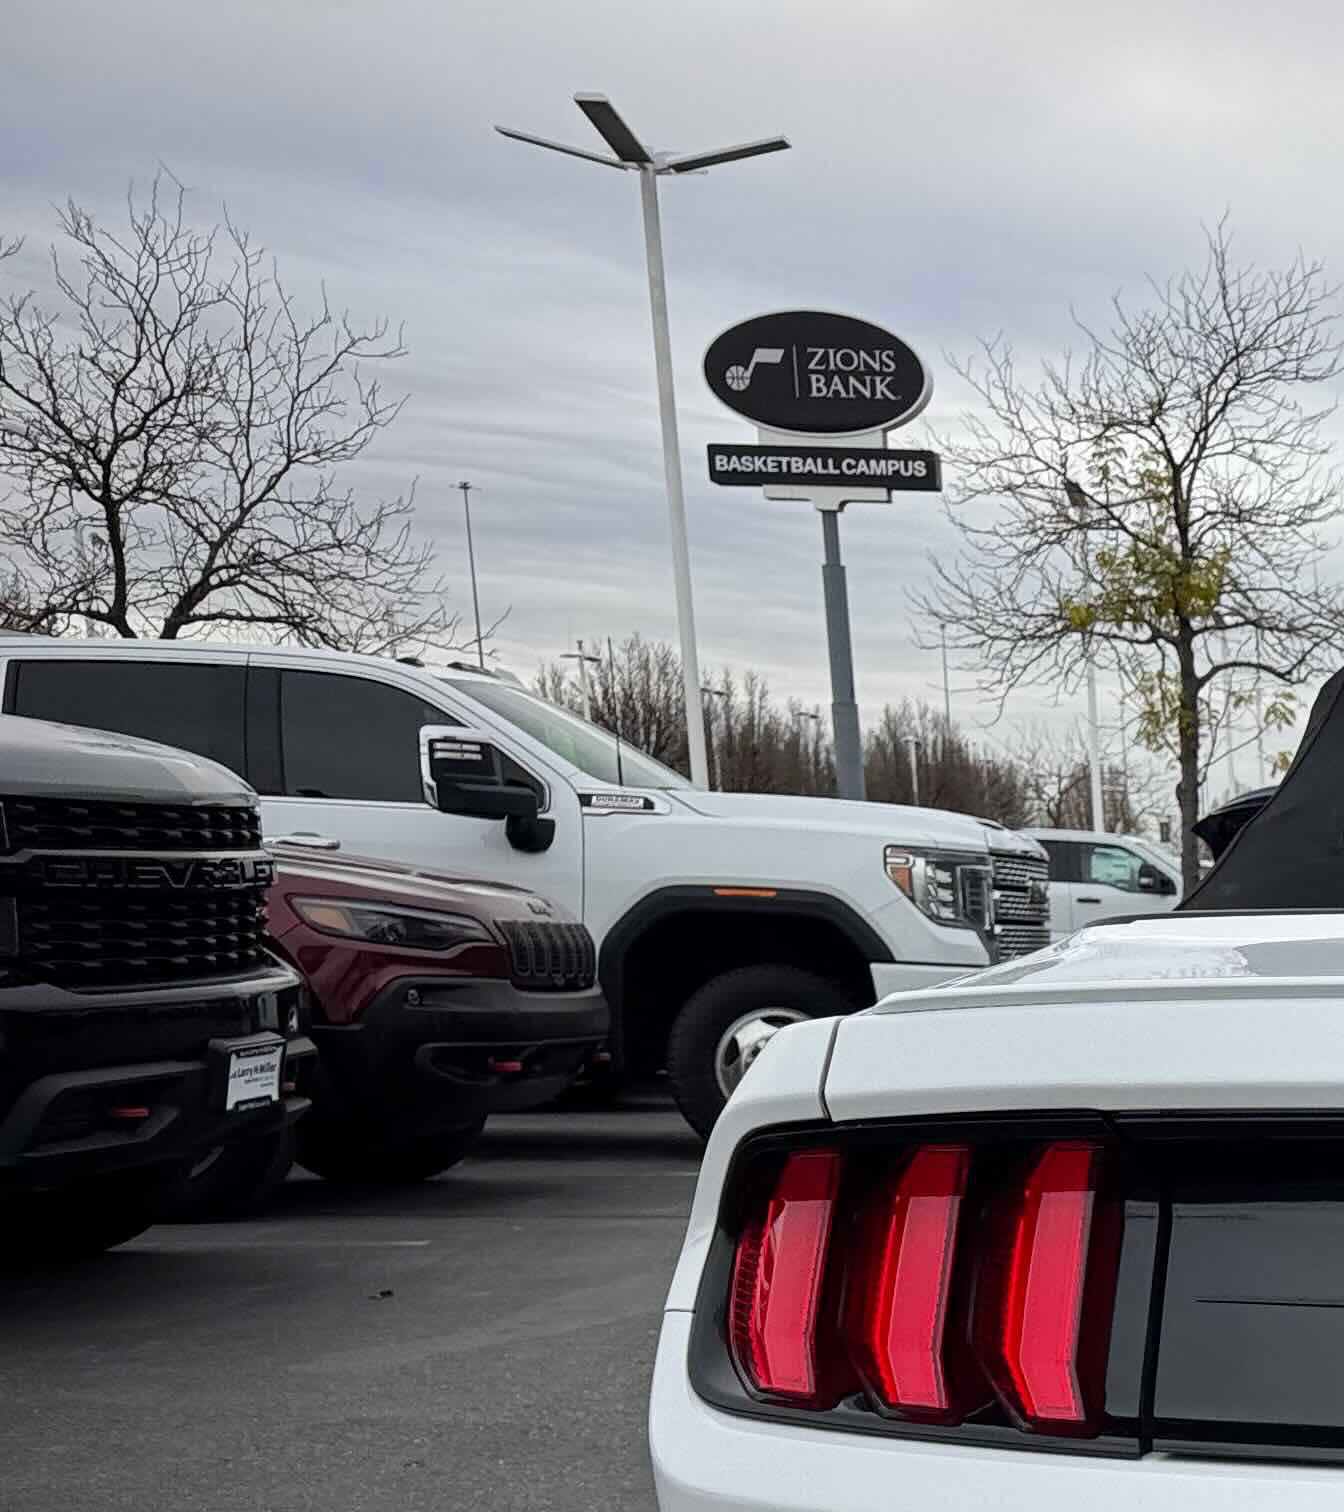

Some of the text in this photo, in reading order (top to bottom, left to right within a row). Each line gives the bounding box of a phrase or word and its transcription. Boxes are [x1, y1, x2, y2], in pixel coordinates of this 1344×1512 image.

[807, 346, 896, 373] ZIONS
[808, 373, 897, 400] BANK
[714, 454, 928, 477] BASKETBALL CAMPUS
